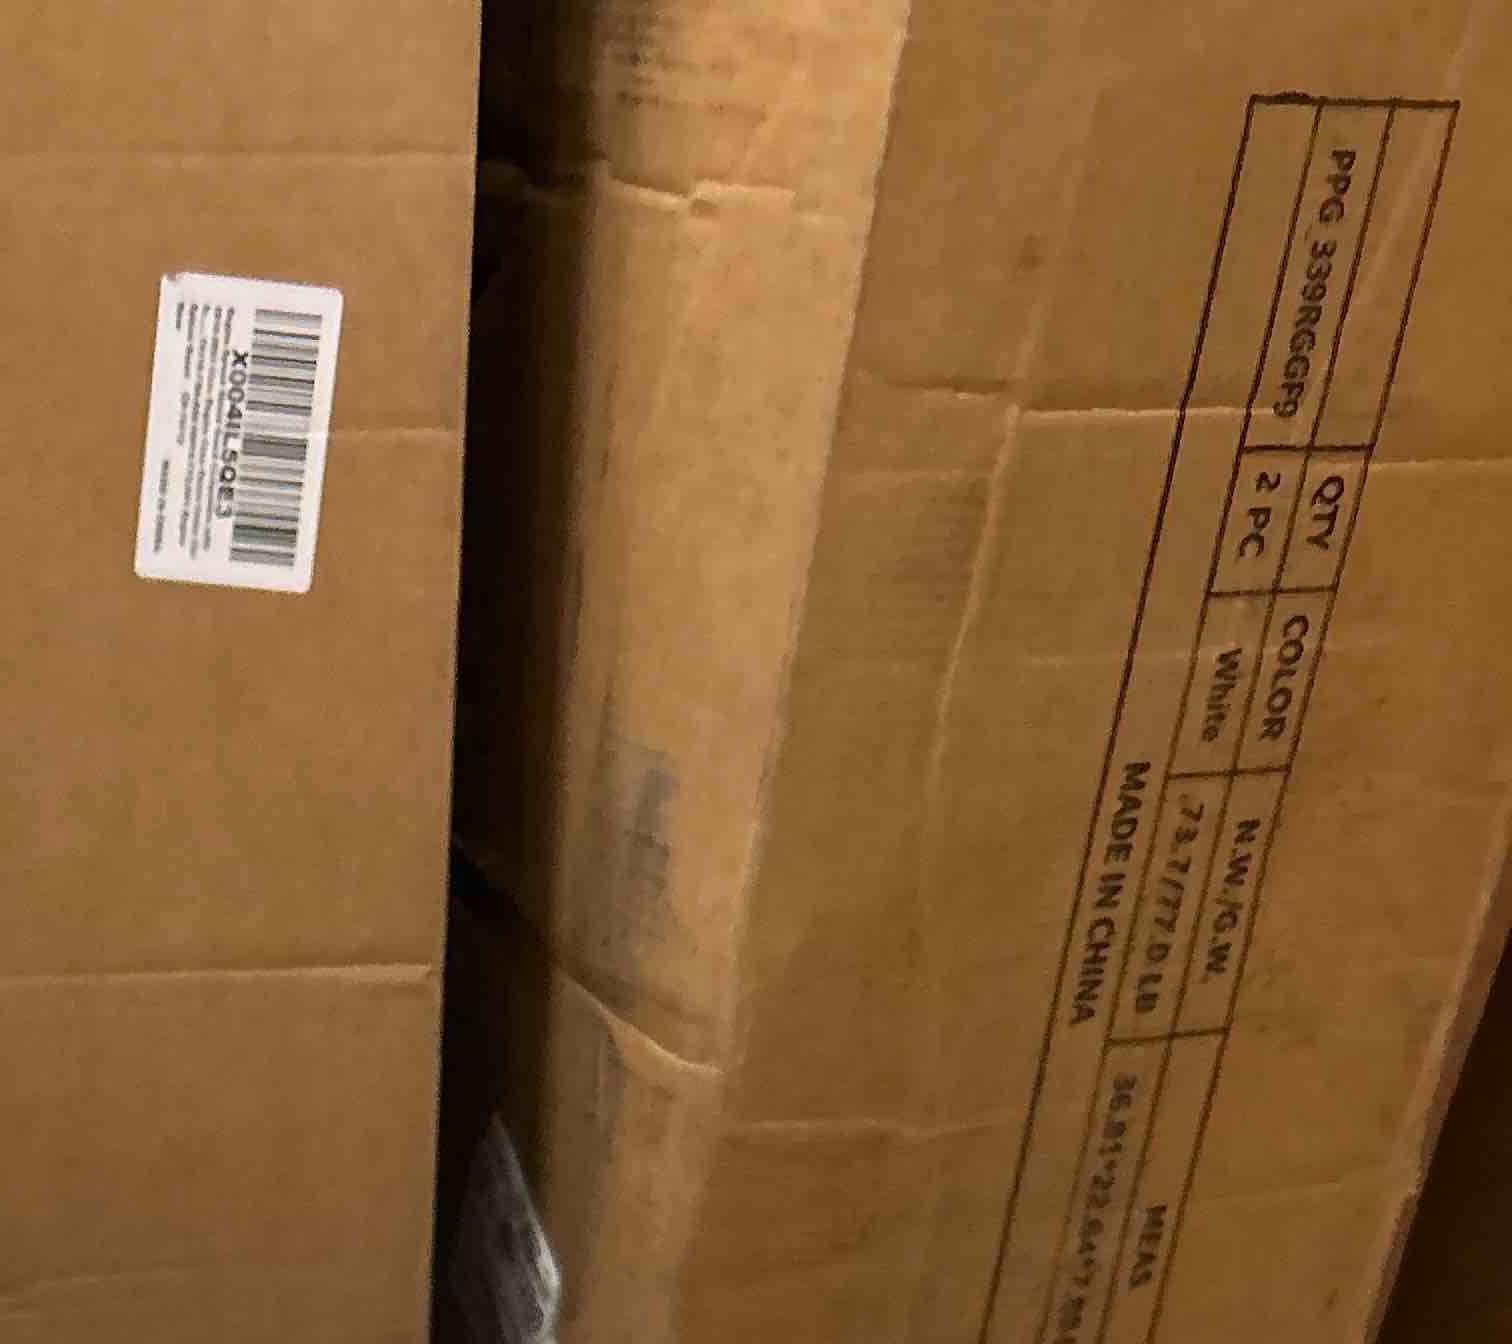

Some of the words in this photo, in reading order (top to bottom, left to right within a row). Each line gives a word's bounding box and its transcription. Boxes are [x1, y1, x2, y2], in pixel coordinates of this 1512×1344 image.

[1319, 147, 1356, 225] PPG
[1255, 471, 1280, 492] 2
[1307, 474, 1344, 551] QTY
[1239, 509, 1271, 559] PC
[1201, 647, 1243, 743] White
[1259, 614, 1309, 740] COLOR
[1103, 760, 1151, 864] MADE
[1098, 869, 1128, 913] IN
[1069, 914, 1117, 1028] CHINA
